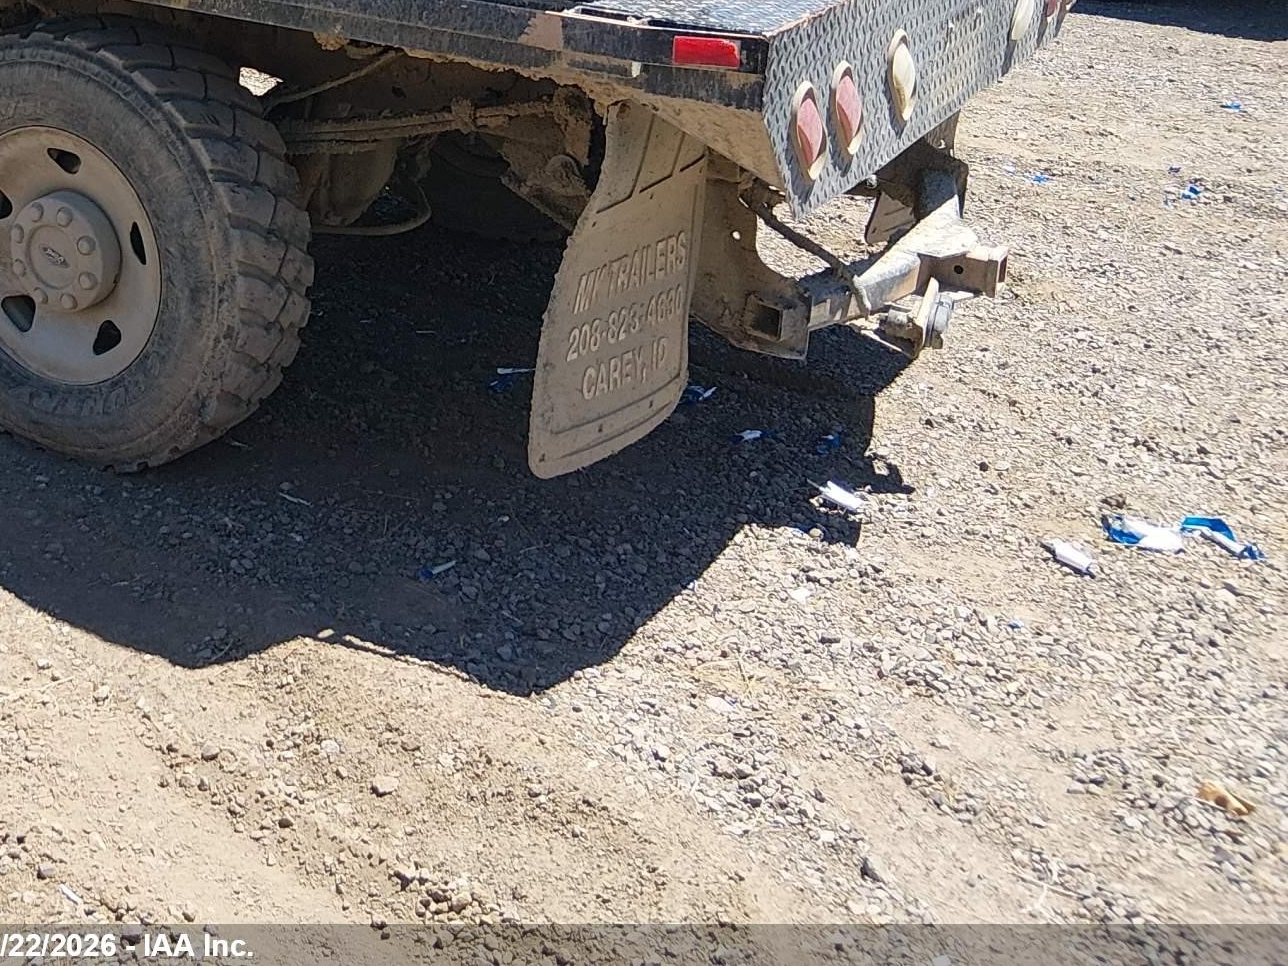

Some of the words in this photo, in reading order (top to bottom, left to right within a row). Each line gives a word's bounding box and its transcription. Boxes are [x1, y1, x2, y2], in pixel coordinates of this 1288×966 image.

[609, 230, 687, 295] TRAILERS
[582, 346, 647, 400] CAREY,
[651, 336, 667, 370] ID
